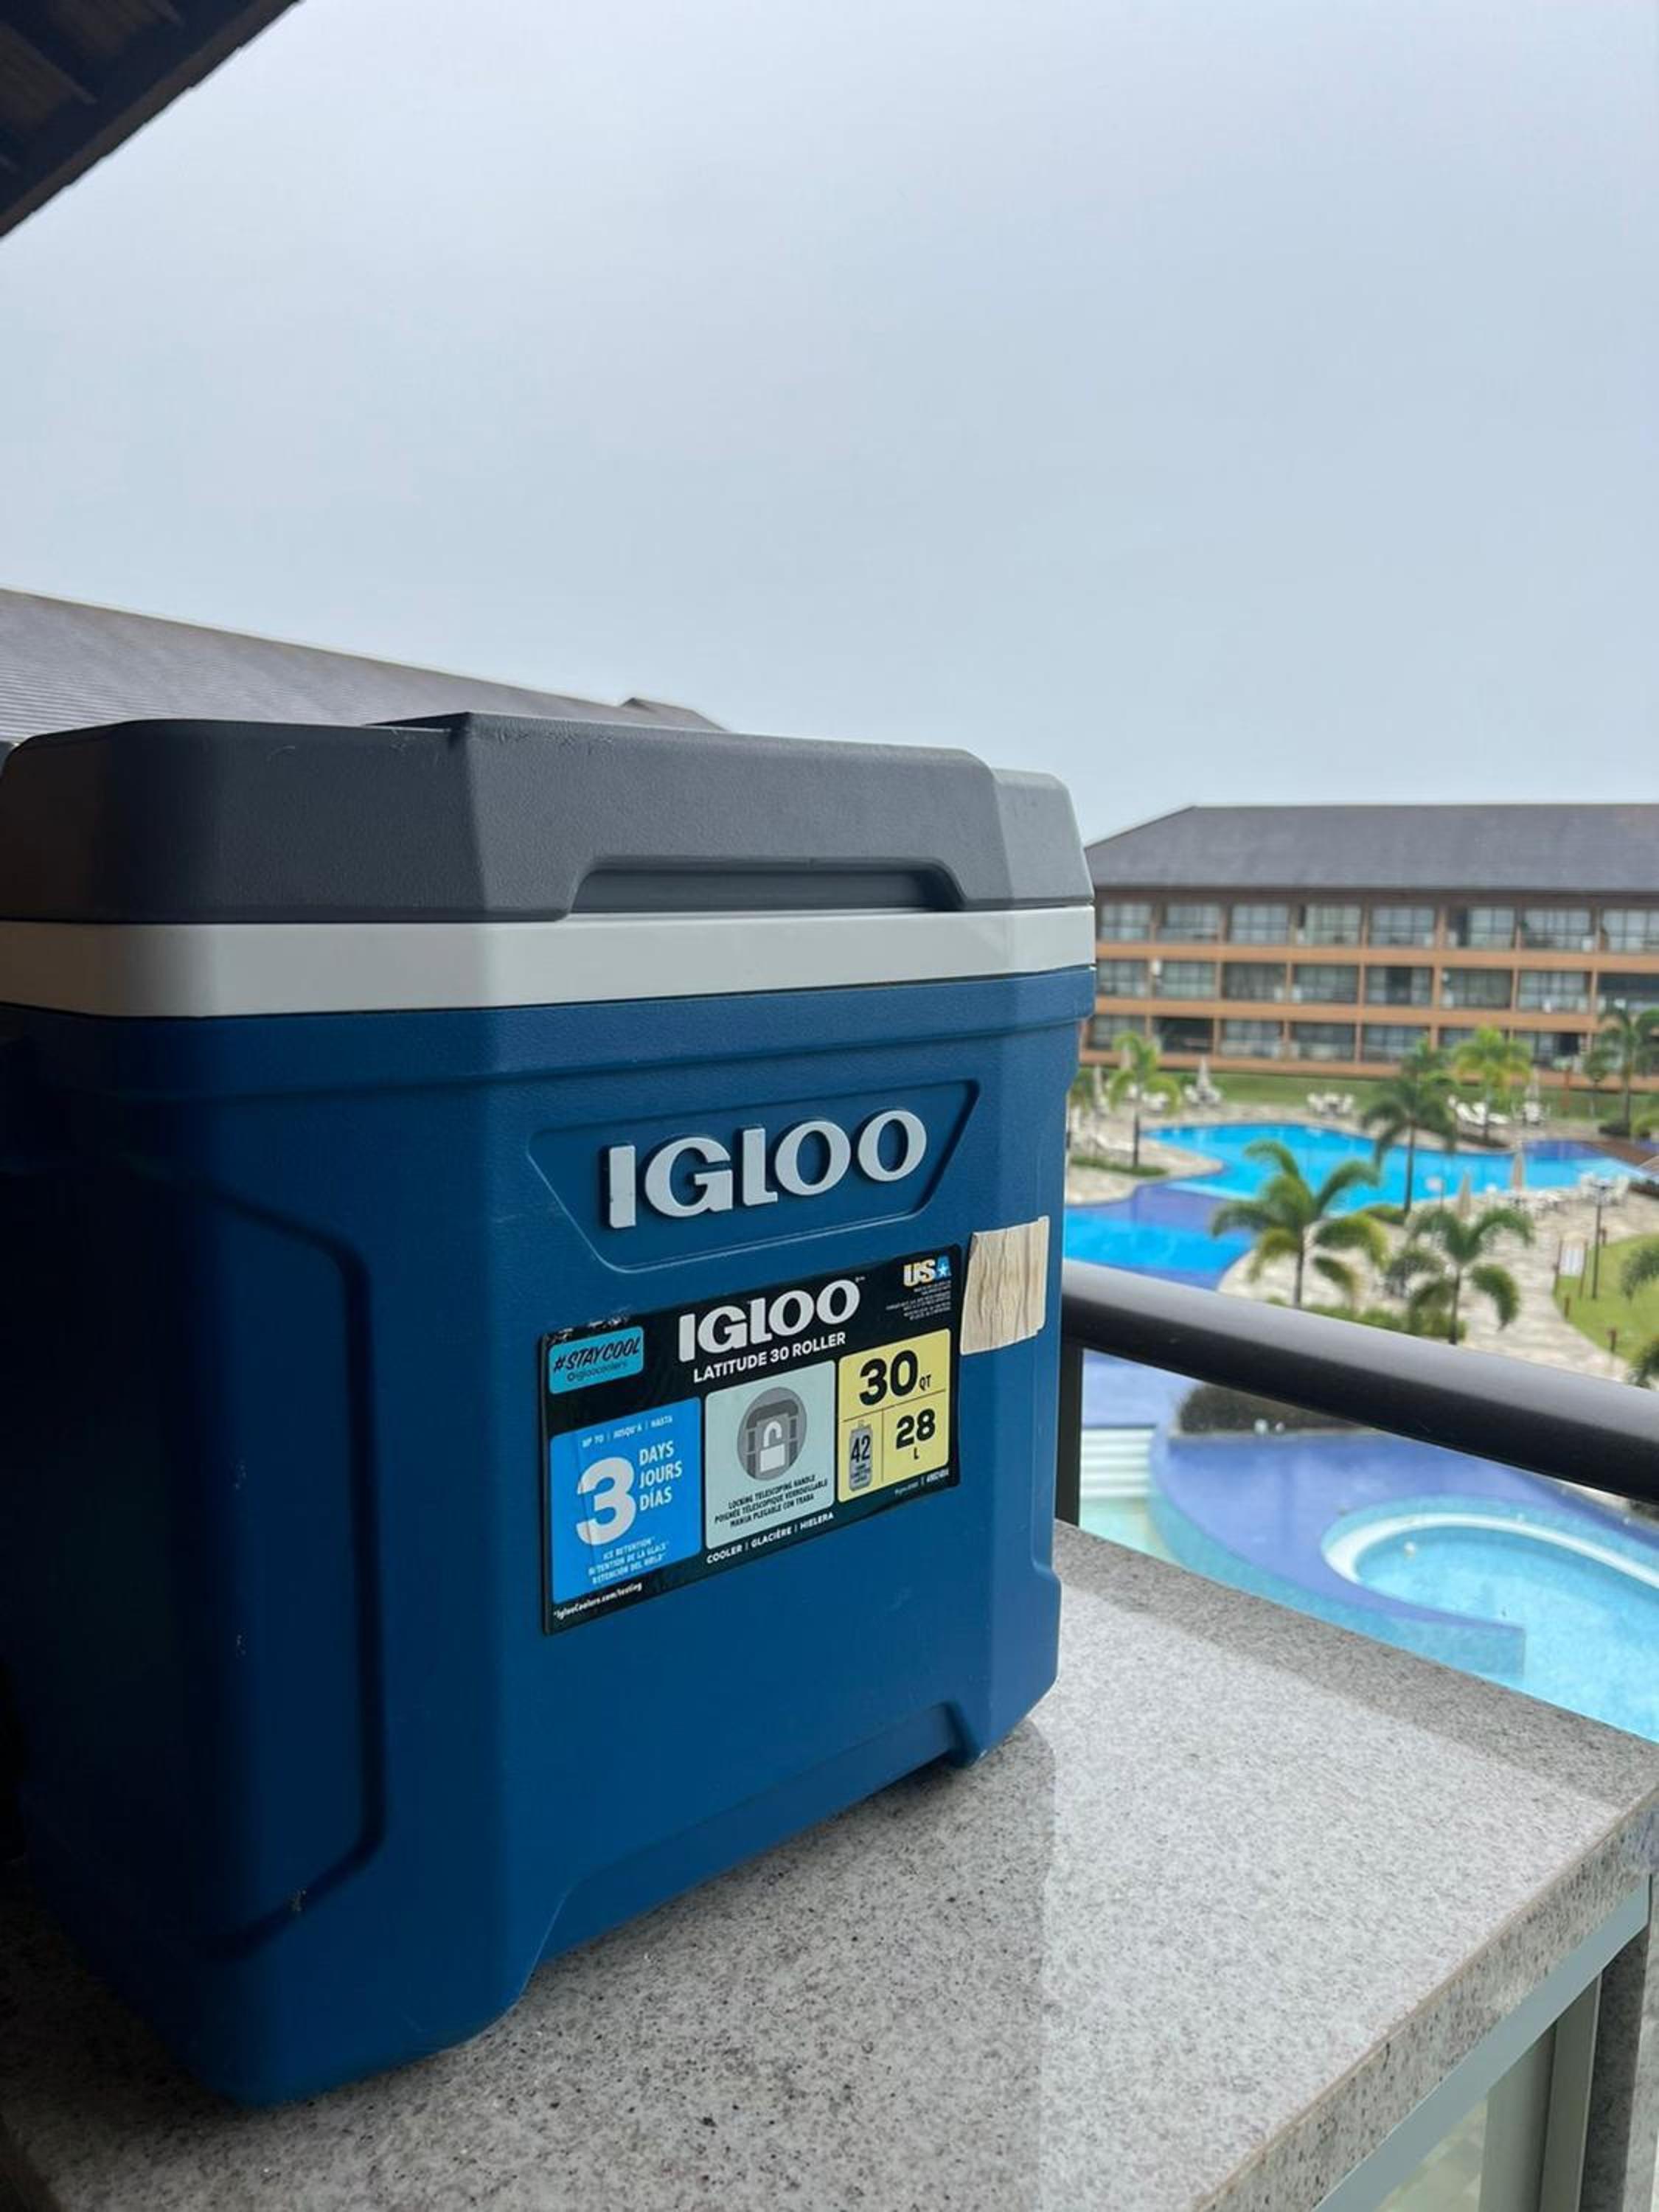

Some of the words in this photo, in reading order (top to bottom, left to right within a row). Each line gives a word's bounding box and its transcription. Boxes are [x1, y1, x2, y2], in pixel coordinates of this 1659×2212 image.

[608, 1109, 928, 1229] IGLOO
[902, 1256, 952, 1287] USA
[678, 1279, 860, 1363] IGLOO
[554, 1337, 641, 1373] #STAYCOOL
[693, 1351, 768, 1383] LATITUDE
[769, 1346, 789, 1363] 30
[792, 1331, 846, 1357] ROLLER
[859, 1349, 918, 1406] 30
[919, 1374, 931, 1391] QT
[851, 1434, 871, 1463] 42
[896, 1408, 936, 1450] 28
[639, 1439, 674, 1467] DAYS
[914, 1447, 919, 1460] L
[639, 1461, 682, 1489] JOURS
[576, 1455, 636, 1545] 3
[639, 1485, 672, 1512] DÍAS
[706, 1545, 742, 1564] COOLER
[751, 1526, 792, 1548] GLACIÈRE
[800, 1512, 835, 1530] HIELERA
